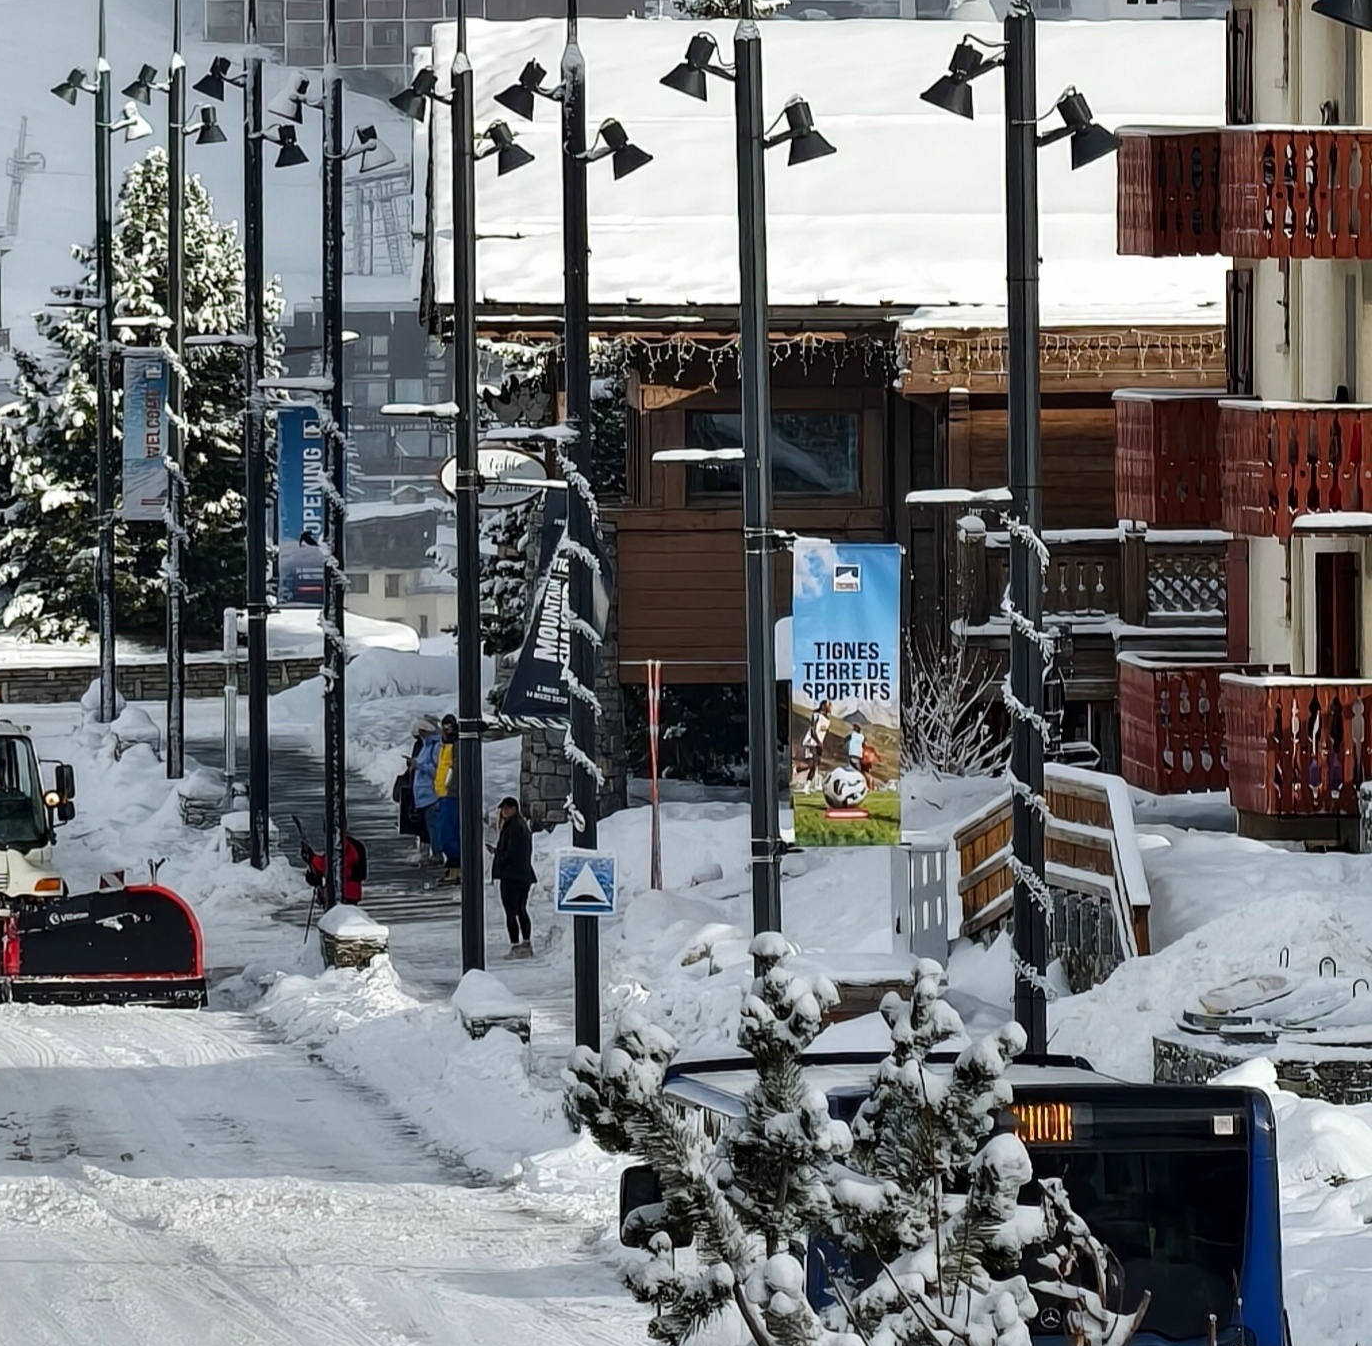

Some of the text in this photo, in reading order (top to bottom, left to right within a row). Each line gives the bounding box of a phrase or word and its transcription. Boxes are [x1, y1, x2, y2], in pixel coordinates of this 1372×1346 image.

[302, 448, 322, 535] OPENING
[813, 641, 880, 661] TIGNES
[802, 662, 891, 681] TERRE DE
[802, 682, 891, 701] SPORTIFS
